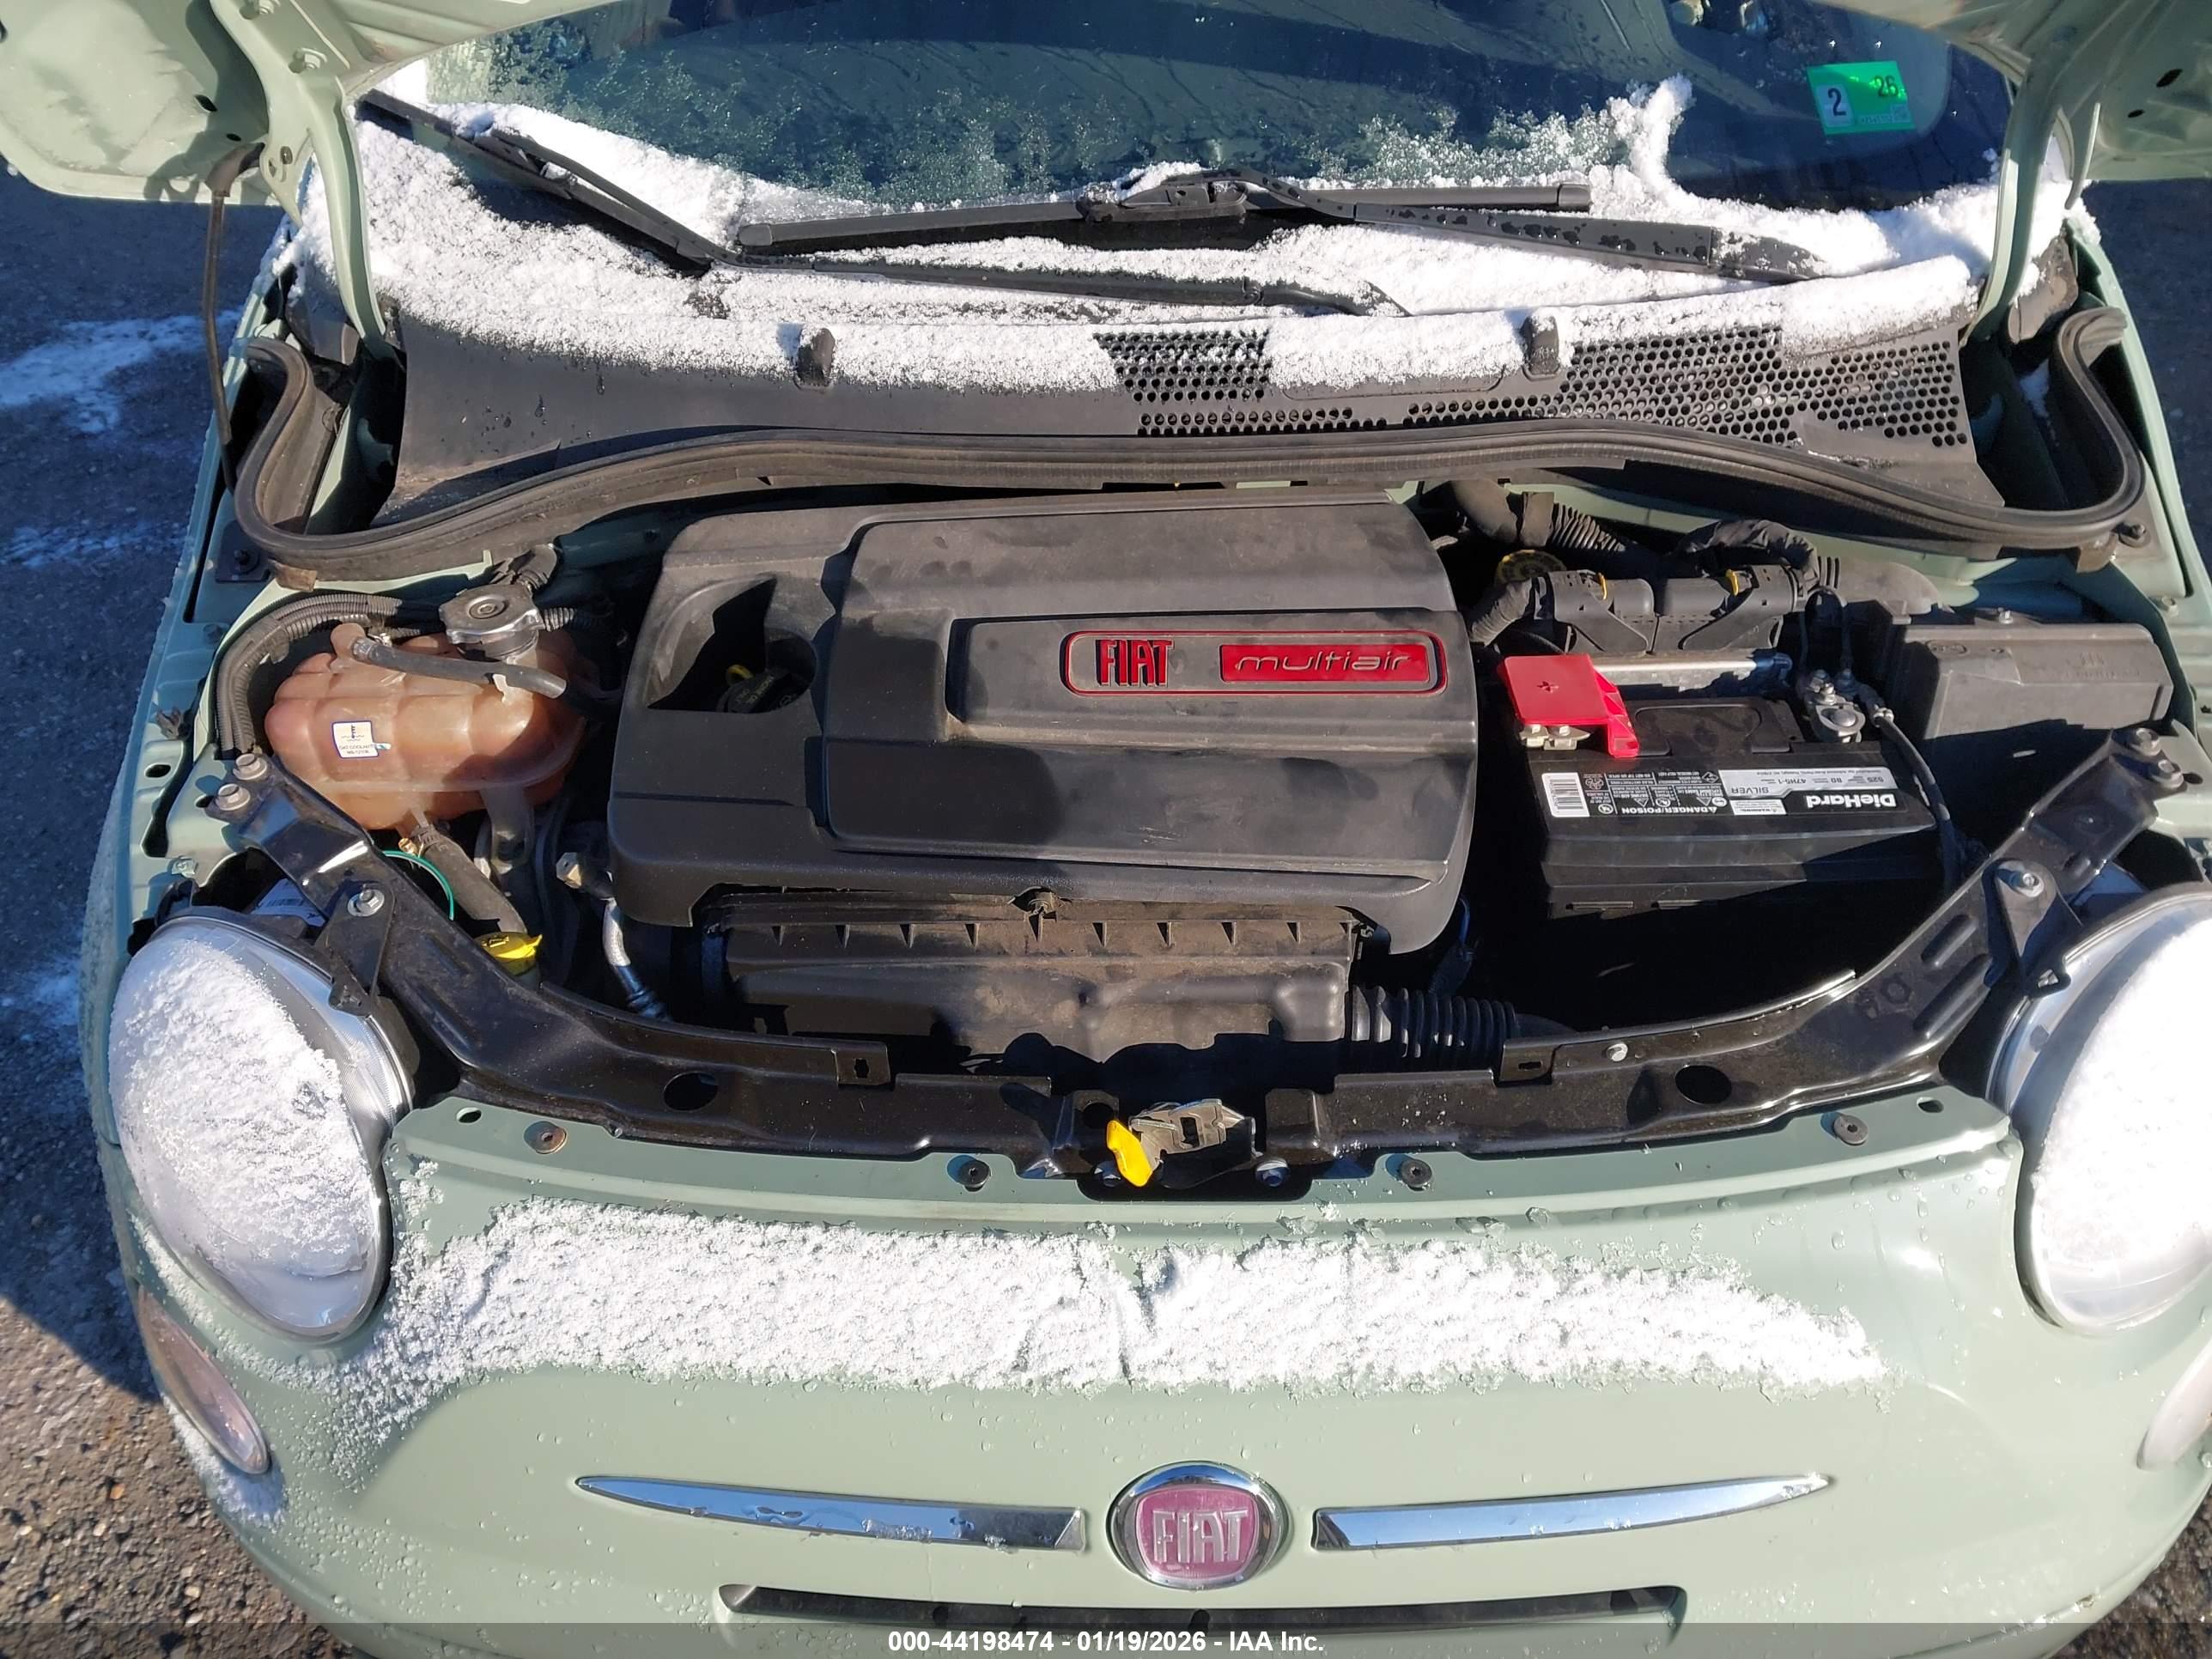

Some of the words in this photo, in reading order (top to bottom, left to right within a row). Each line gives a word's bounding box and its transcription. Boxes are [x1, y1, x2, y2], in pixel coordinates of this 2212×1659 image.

[1874, 75, 1899, 97] 26
[1827, 88, 1847, 117] 2
[1095, 639, 1175, 687] FIAT
[1235, 651, 1411, 672] multiair
[1806, 793, 1897, 808] DieHard
[1152, 1509, 1249, 1564] FIAT
